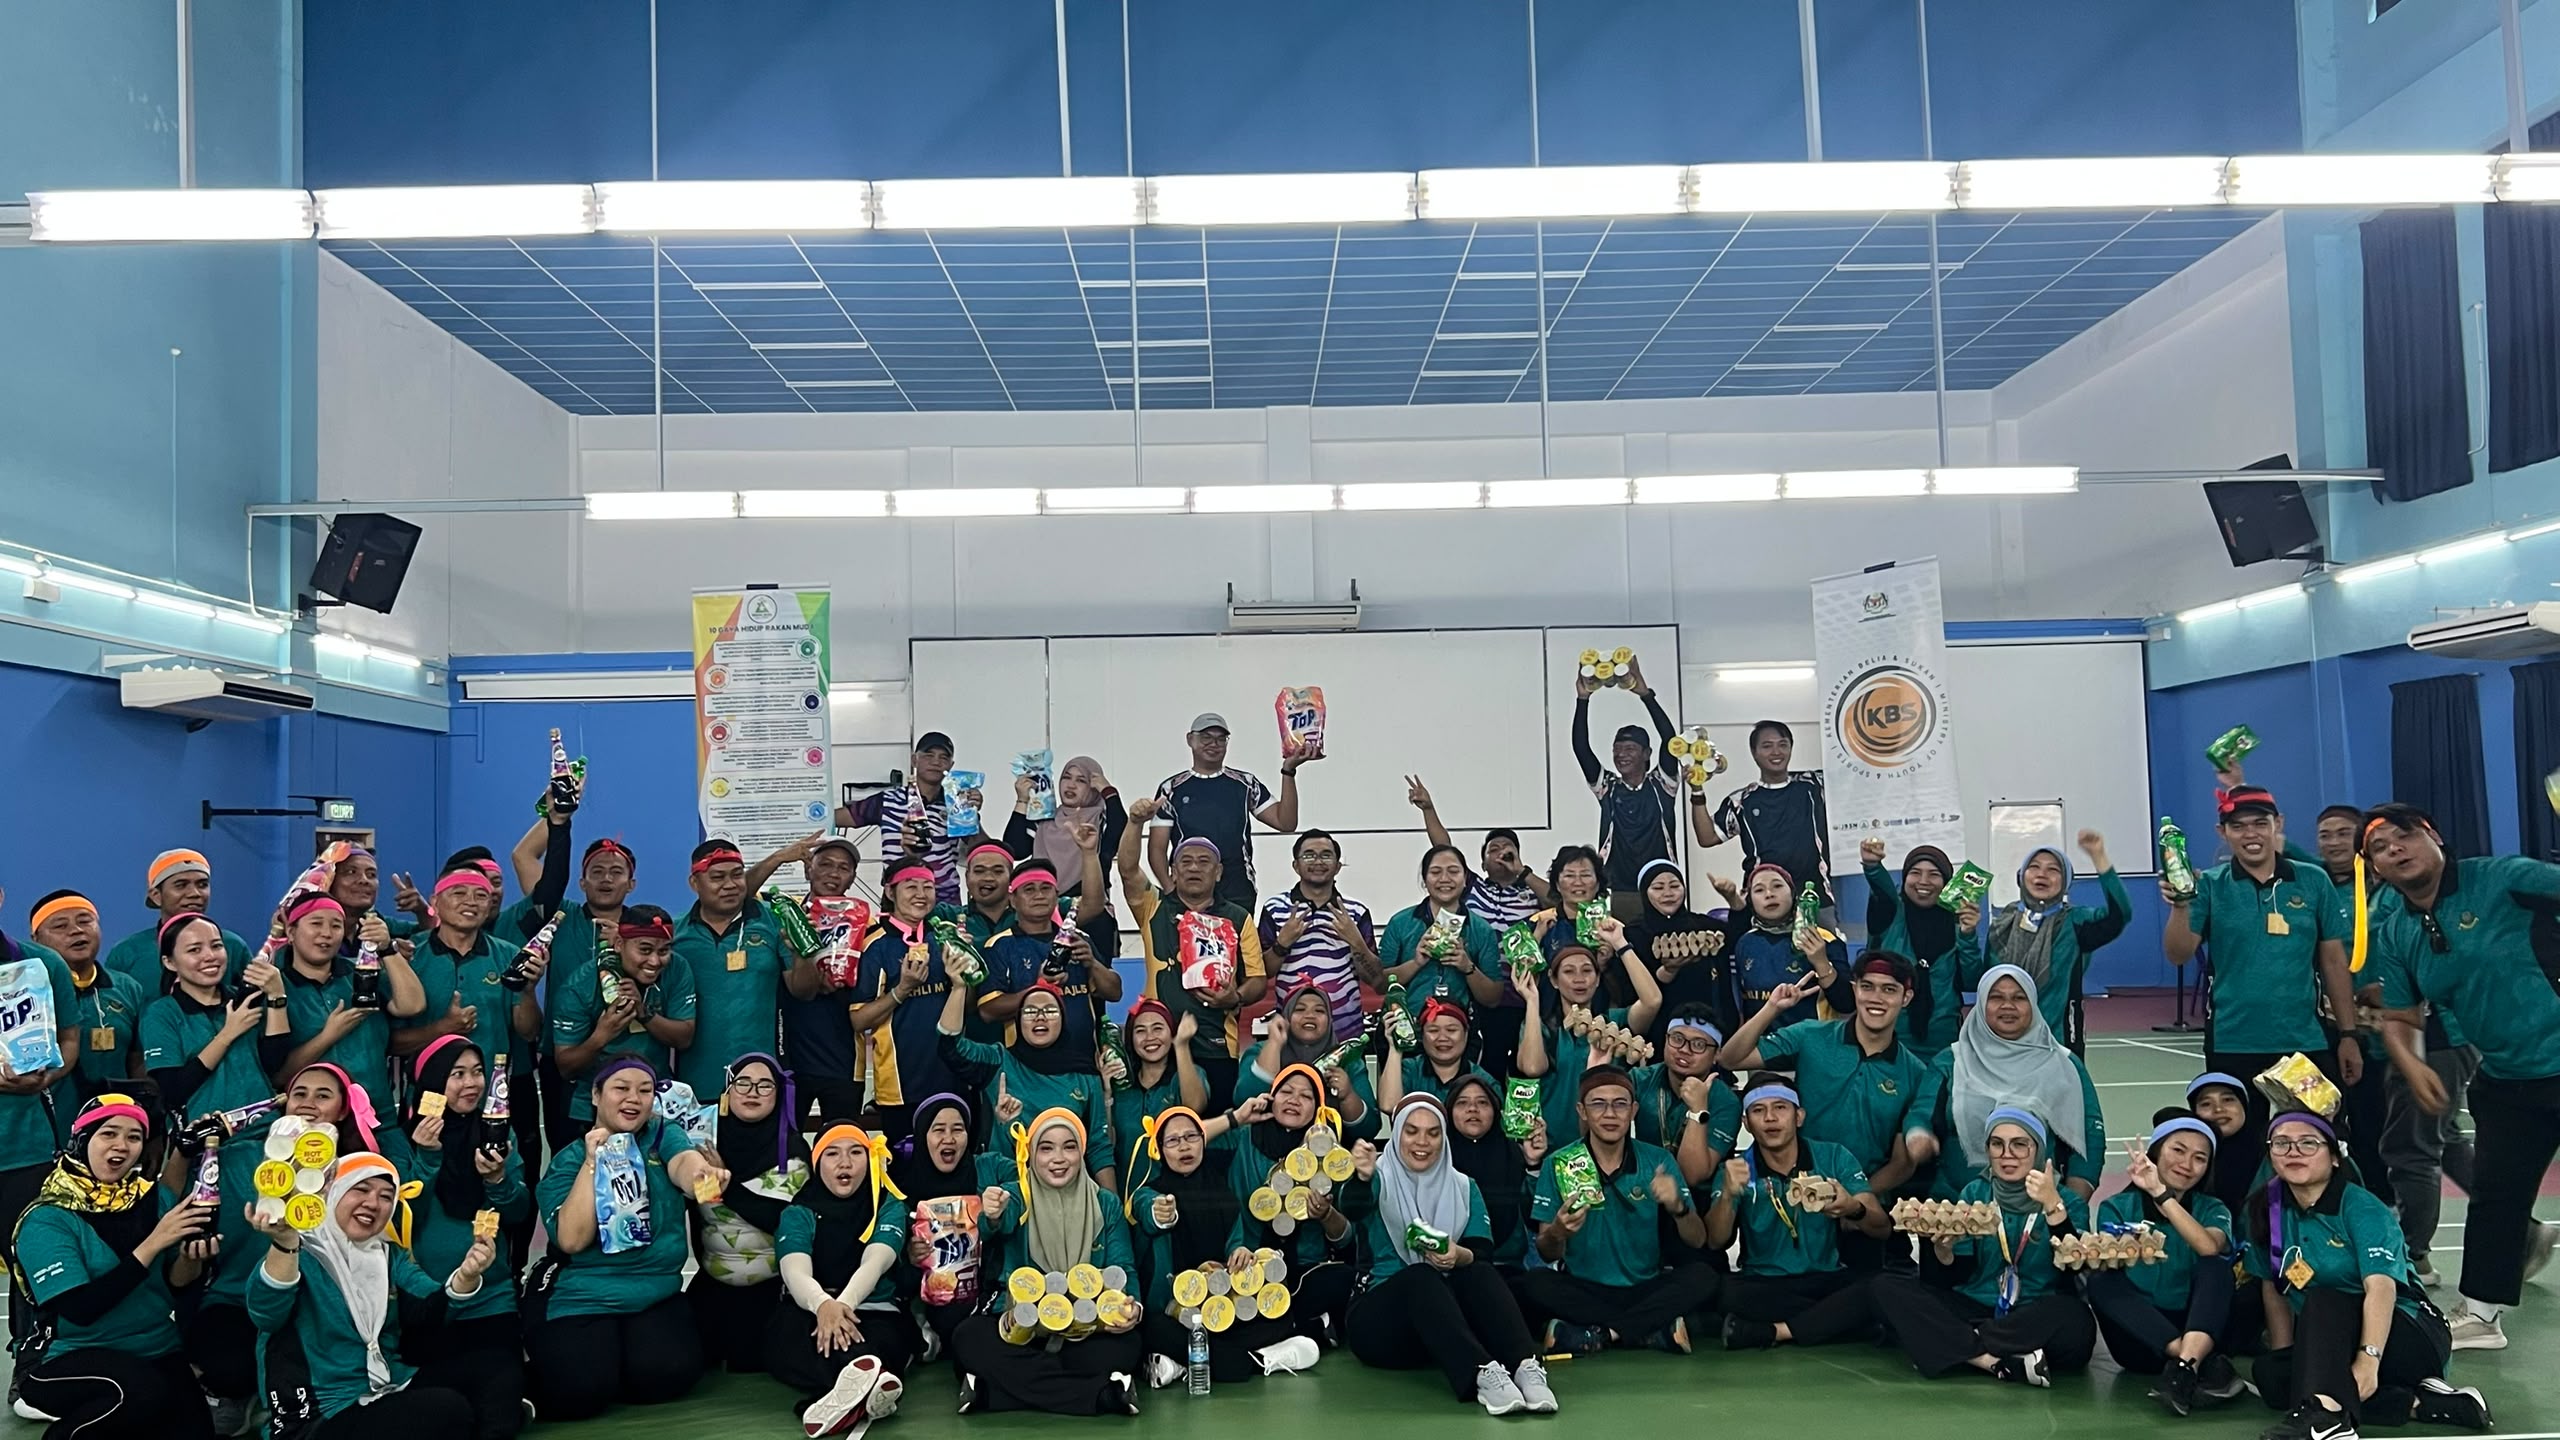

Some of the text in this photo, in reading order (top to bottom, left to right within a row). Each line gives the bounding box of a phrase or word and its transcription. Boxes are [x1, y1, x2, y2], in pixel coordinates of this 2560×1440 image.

[709, 626, 717, 634] 10
[718, 625, 739, 633] GAYA
[1824, 669, 1854, 738] KEMENTERIAN
[1858, 655, 1886, 669] BELIA
[1905, 657, 1935, 681] SUKAN
[1866, 702, 1918, 729] KBS
[1836, 753, 1871, 779] SPORTS
[1887, 762, 1923, 779] YOUTH
[304, 1150, 322, 1158] HOT
